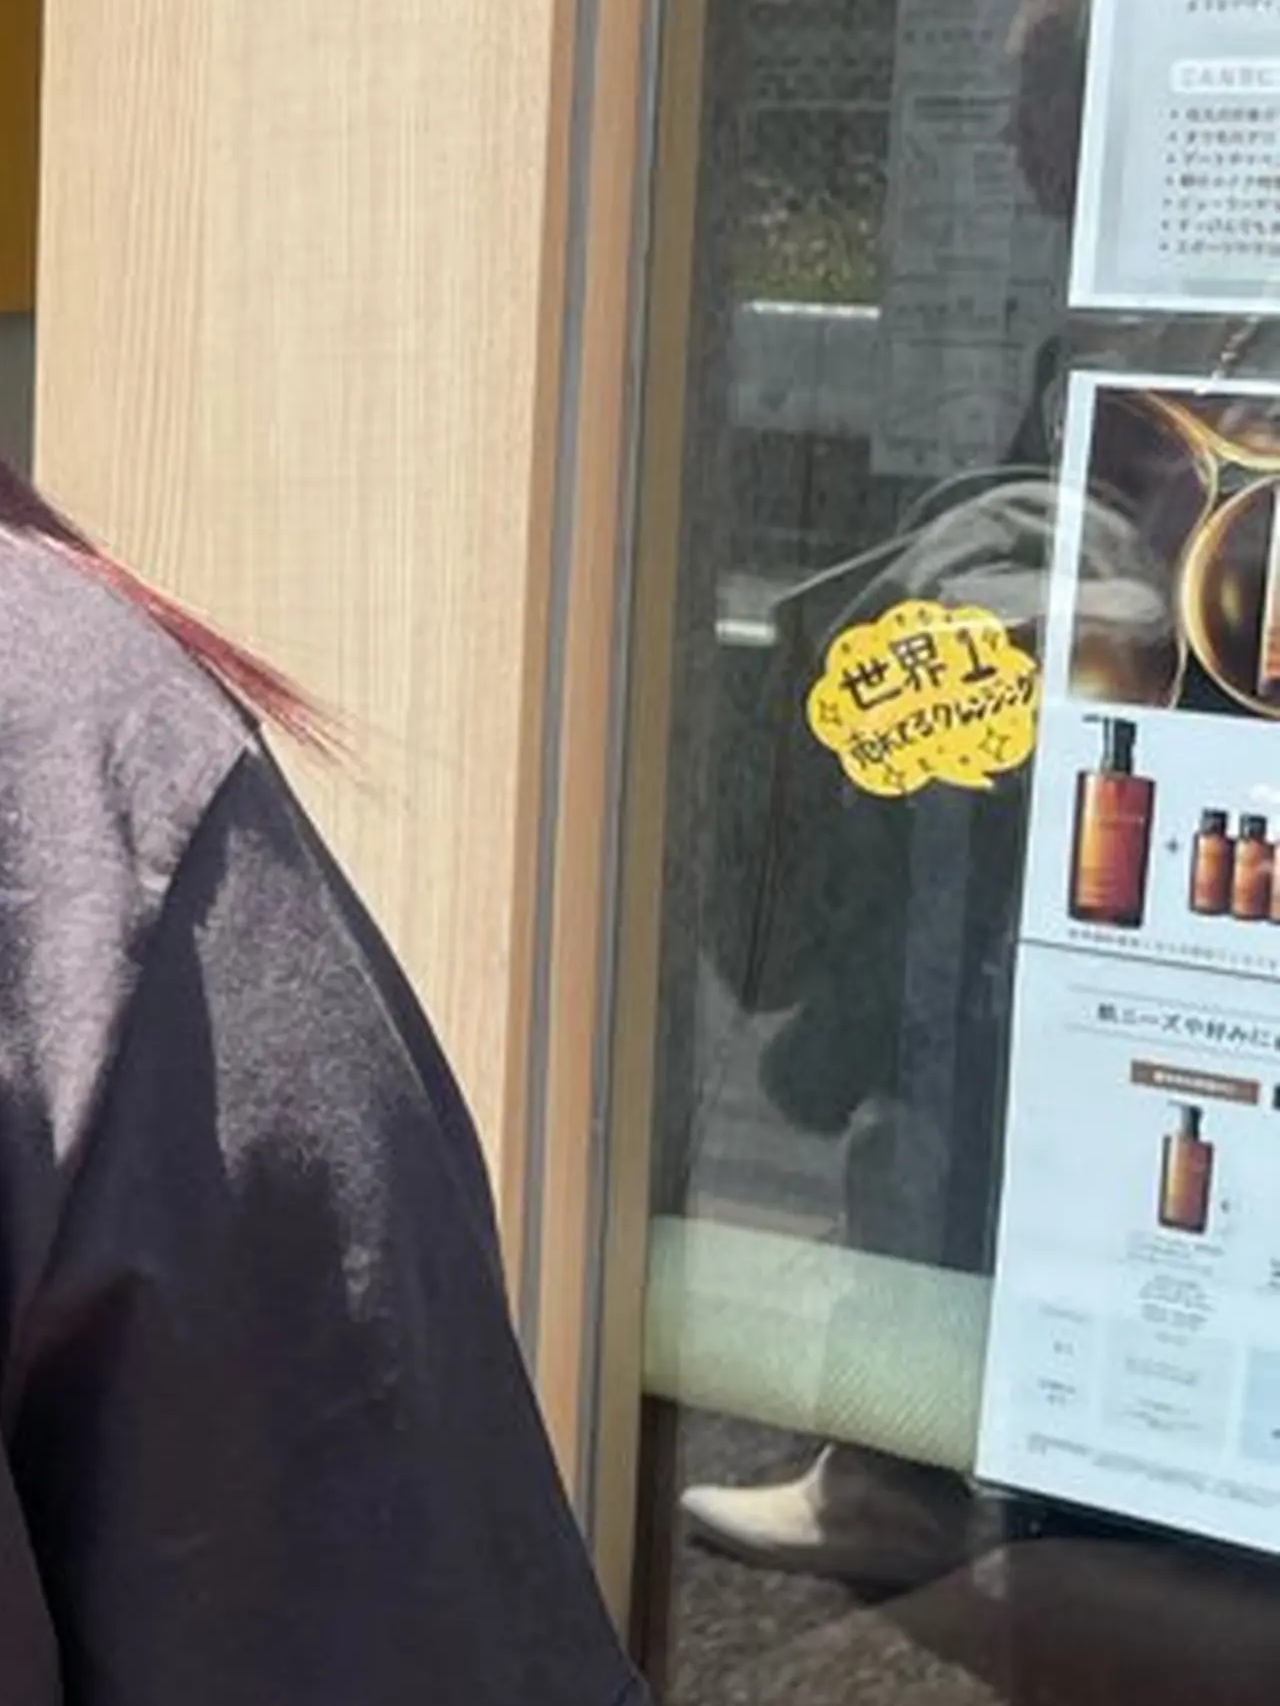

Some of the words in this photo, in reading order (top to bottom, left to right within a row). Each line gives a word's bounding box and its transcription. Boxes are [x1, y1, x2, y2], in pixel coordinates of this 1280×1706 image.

[1097, 1002, 1280, 1051] 肌ニーズや好みに
